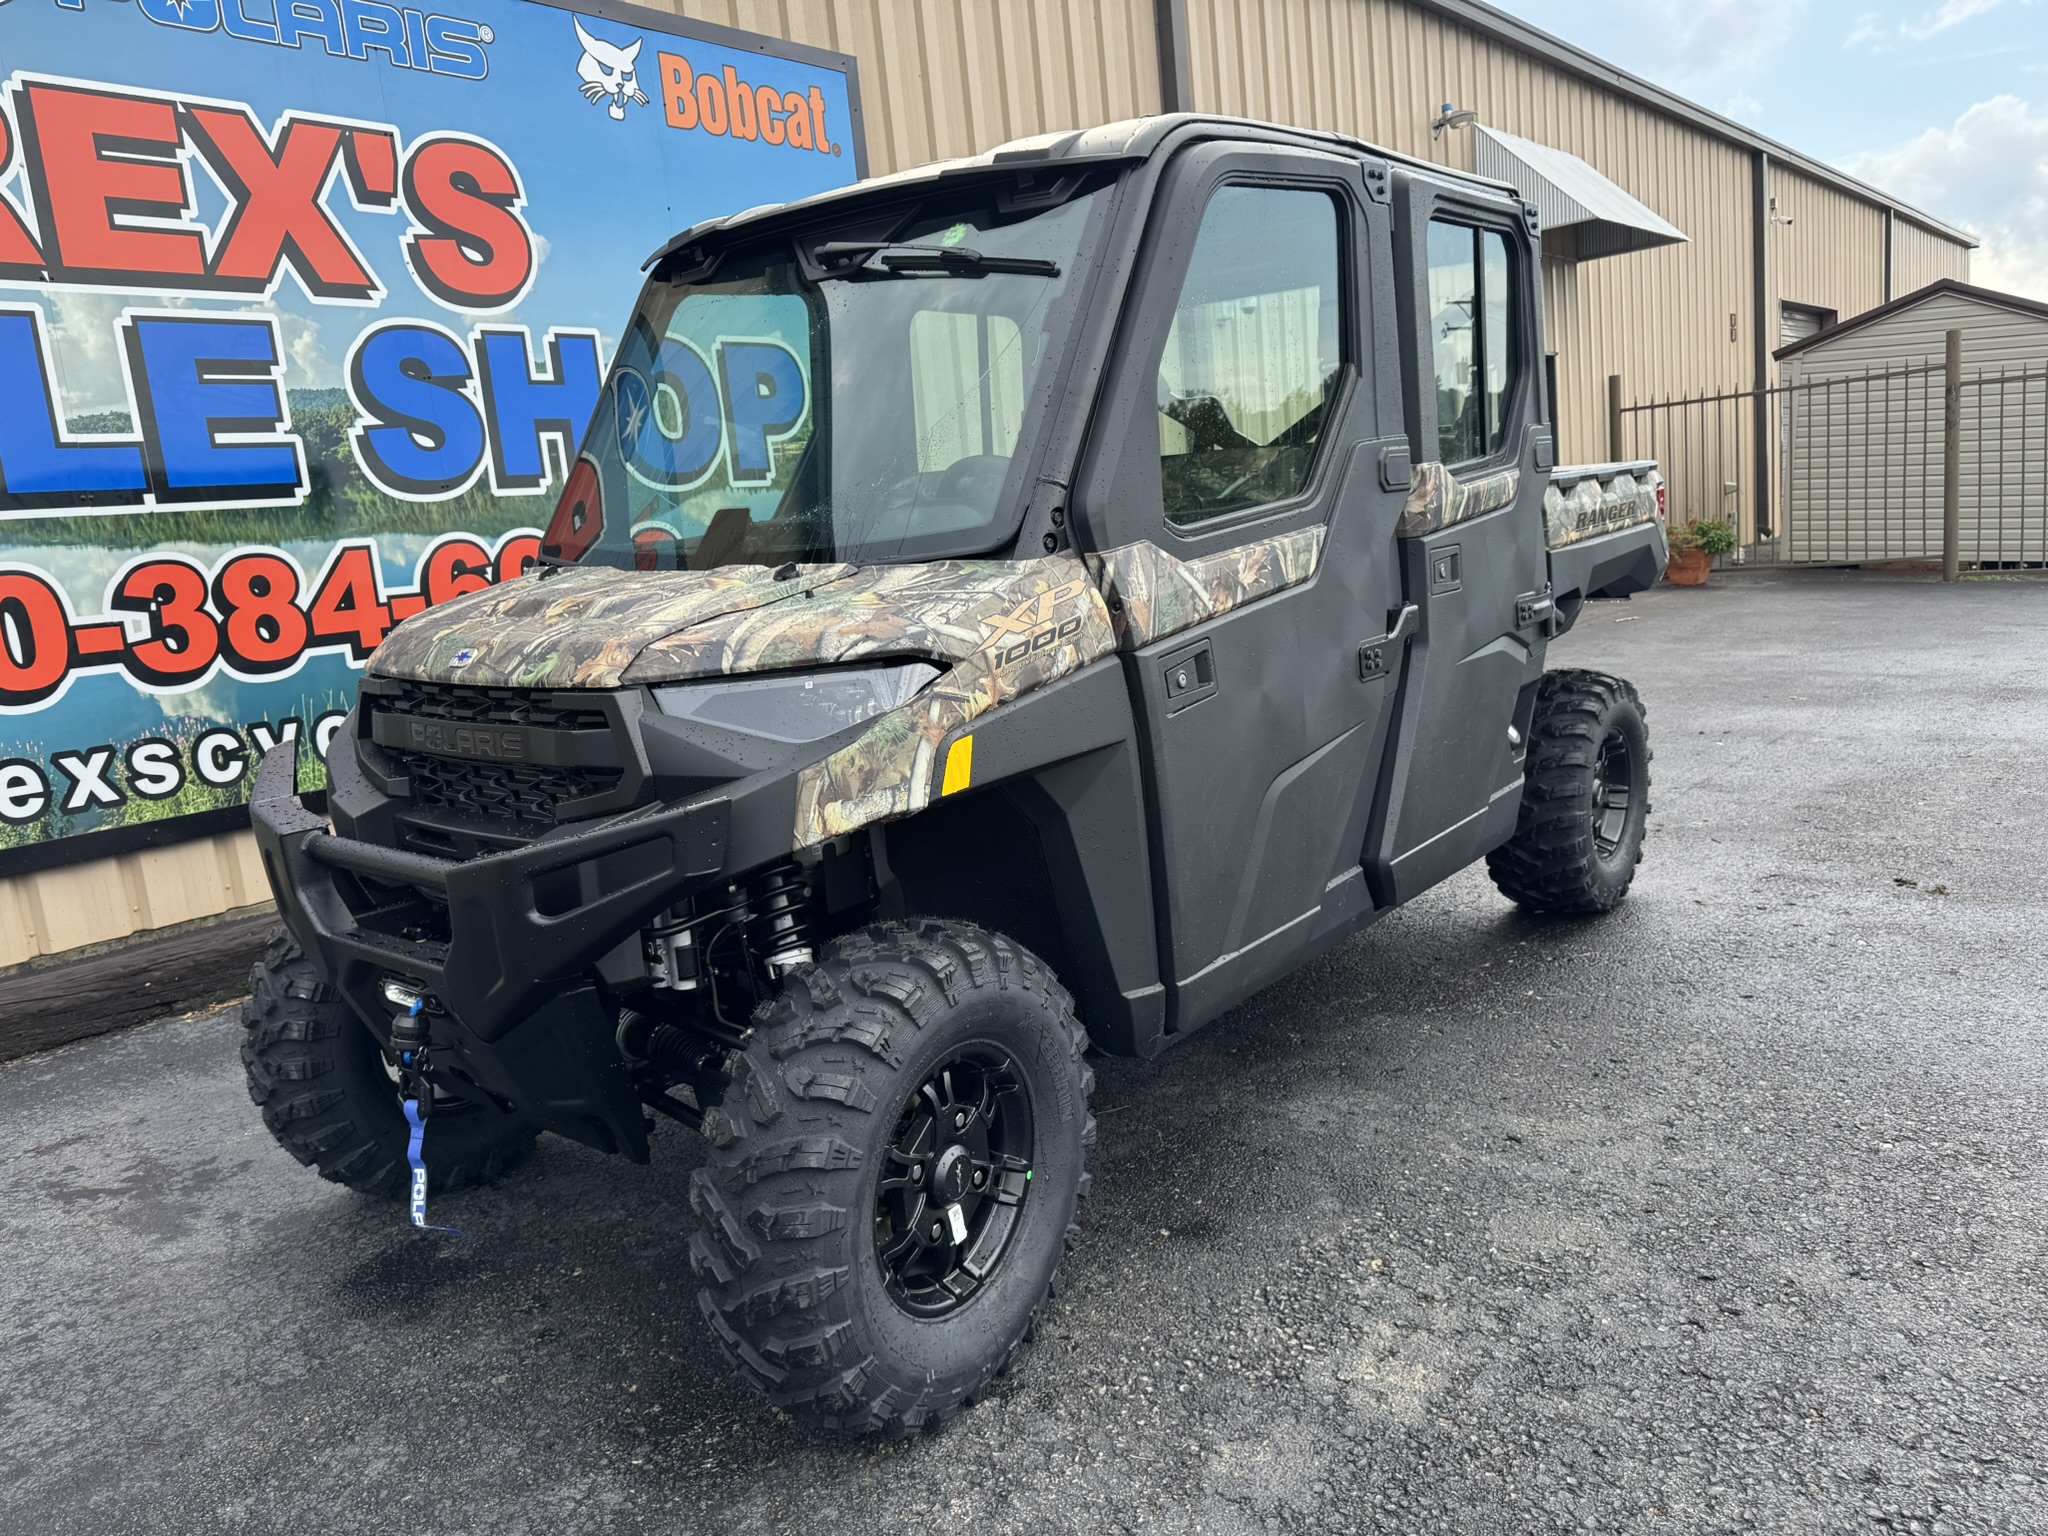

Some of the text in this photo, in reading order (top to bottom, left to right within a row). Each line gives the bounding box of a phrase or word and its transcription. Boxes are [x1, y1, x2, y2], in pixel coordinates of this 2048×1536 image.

[56, 0, 489, 80] OLARIS
[658, 51, 831, 155] Bobcat
[347, 322, 806, 494] SHOP
[1576, 500, 1637, 530] RANGER
[968, 578, 1087, 657] XP
[994, 614, 1084, 671] 1000
[410, 721, 523, 758] POLARIS
